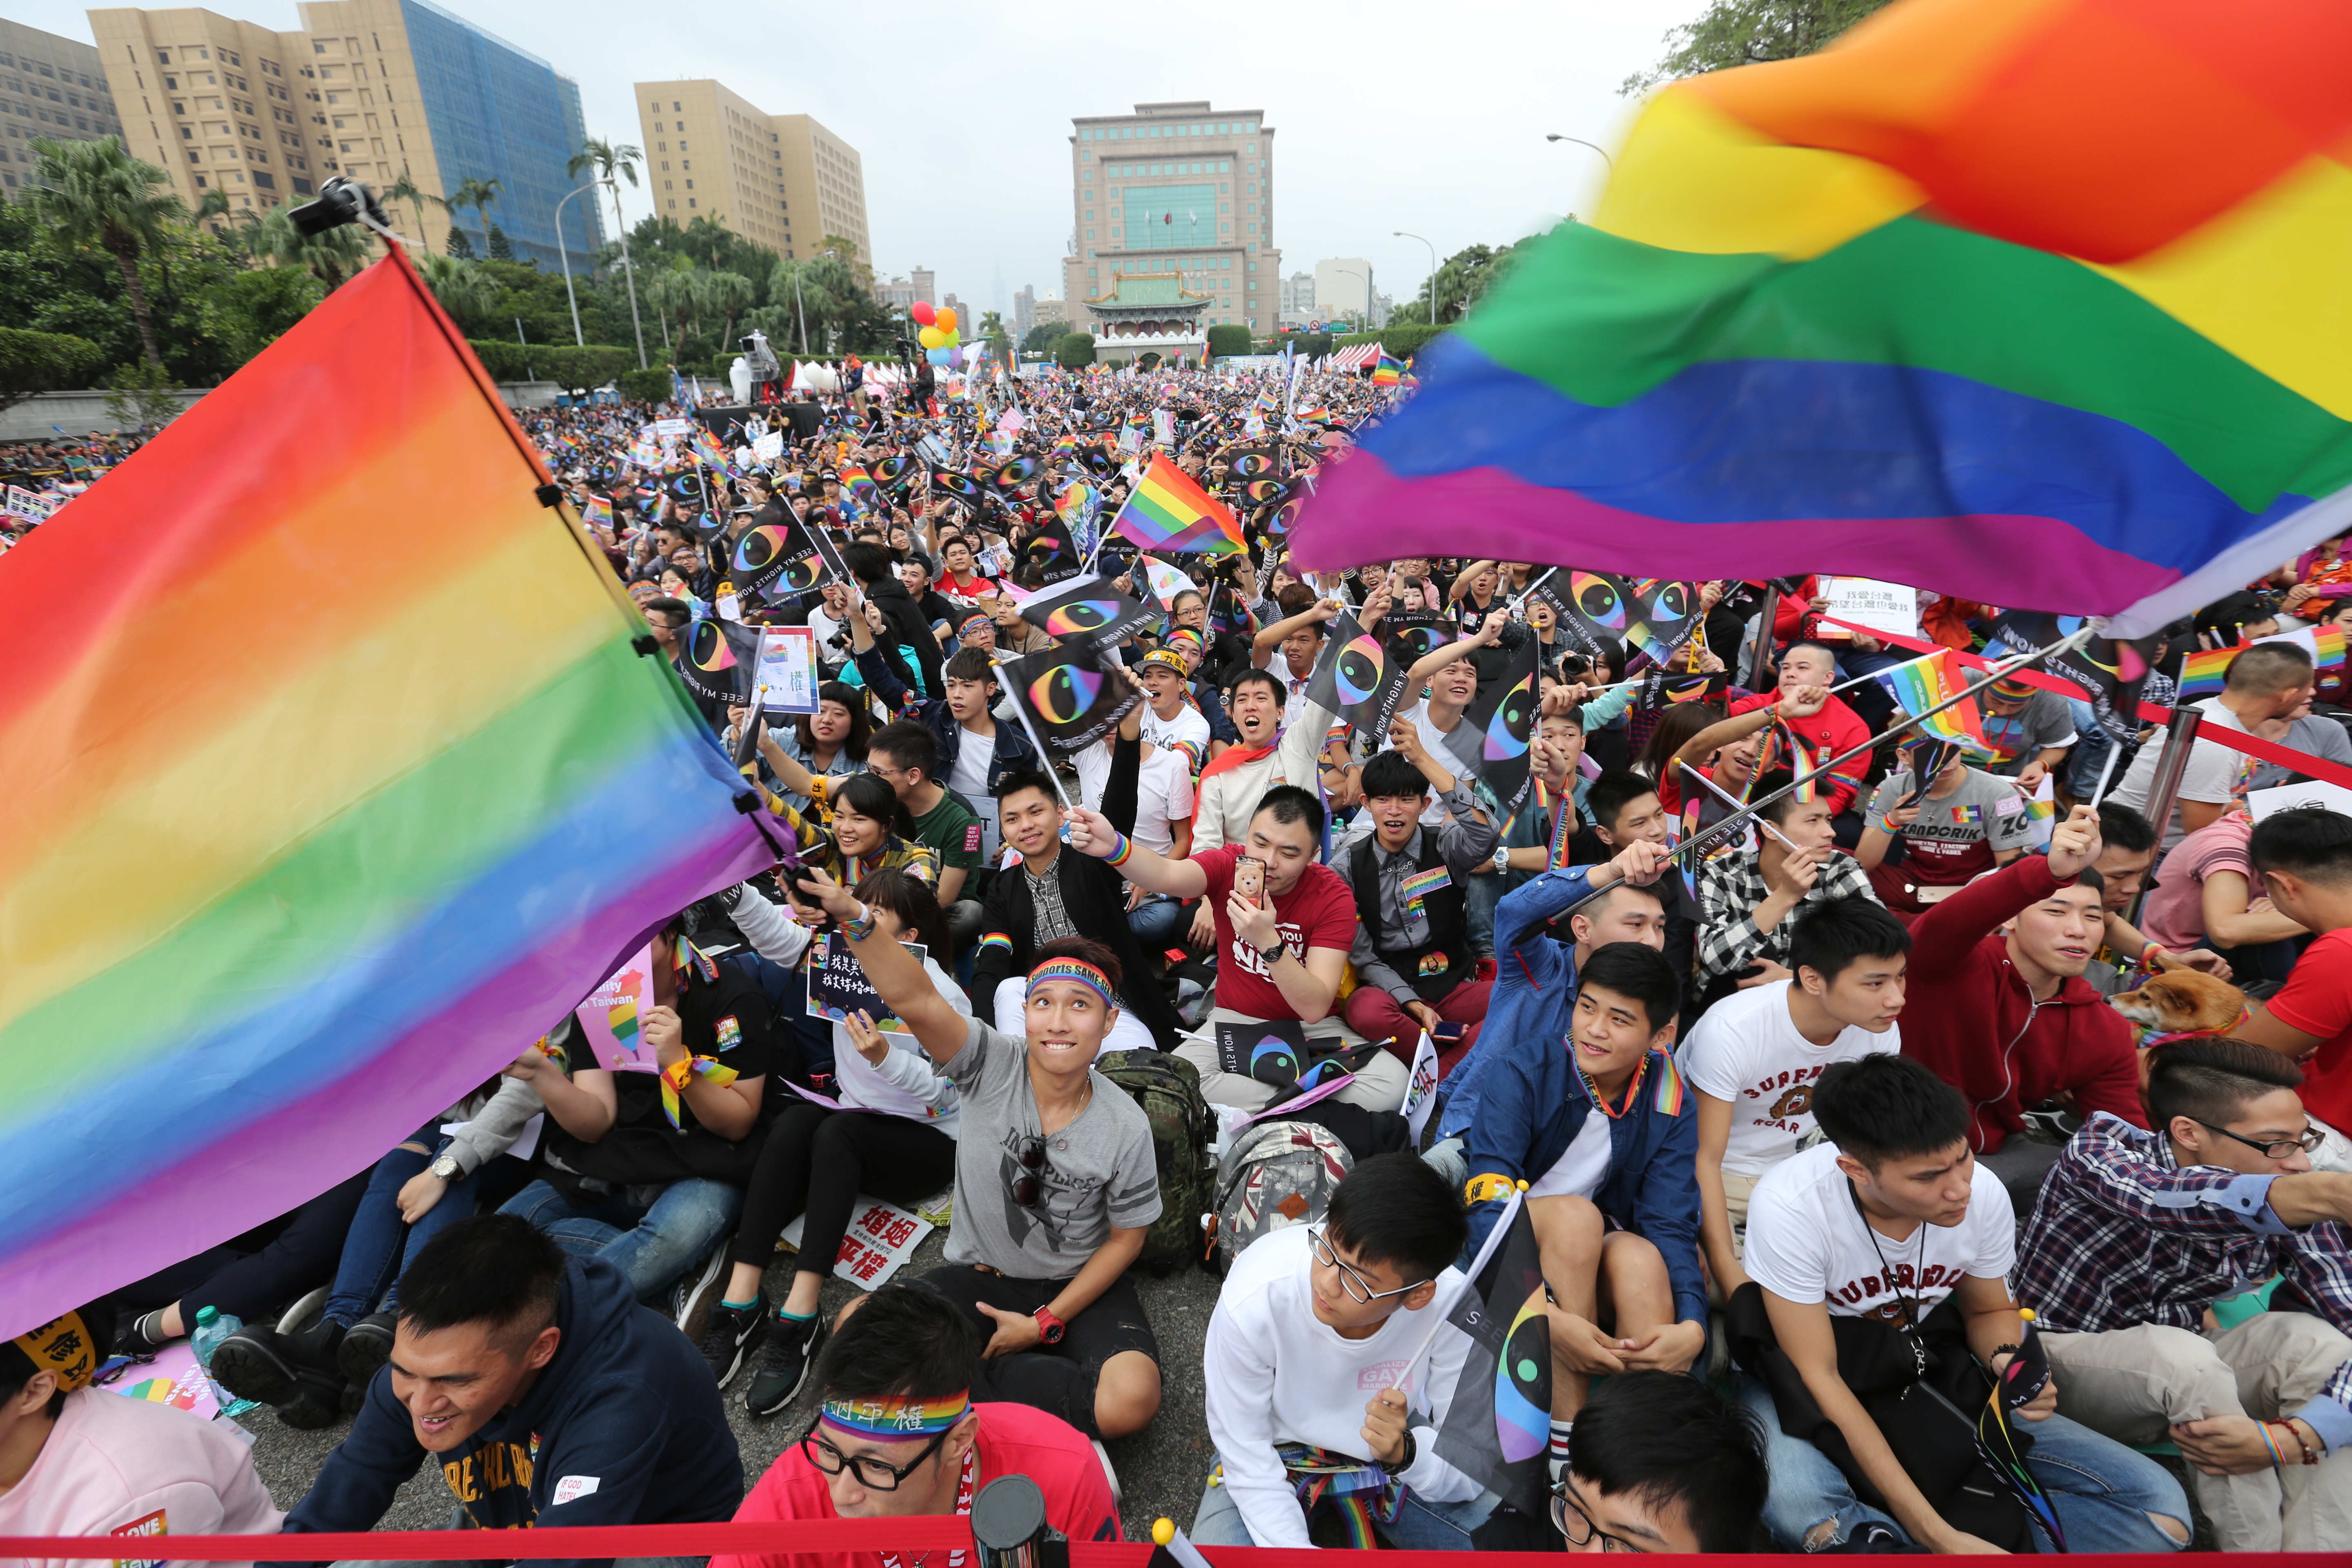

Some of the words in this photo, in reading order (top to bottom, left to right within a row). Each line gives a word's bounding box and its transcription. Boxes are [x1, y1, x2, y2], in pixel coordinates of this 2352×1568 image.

[1846, 590, 1893, 601] 我愛台灣
[1100, 623, 1135, 645] RIGHTS
[1130, 610, 1159, 627] NOW!
[1539, 585, 1555, 599] SEE
[1553, 598, 1566, 611] MY
[1563, 609, 1587, 638] RIGHTS
[1585, 635, 1605, 657] NOW!
[1999, 801, 2020, 811] GAY
[1280, 930, 1303, 943] YOU
[1032, 964, 1072, 982] Supports
[592, 982, 622, 996] ality
[589, 994, 633, 1007] Taiwan
[717, 1018, 735, 1031] LOVE
[720, 1030, 727, 1038] IS
[720, 1034, 740, 1047] LOVE
[856, 1205, 918, 1250] 婚姻
[1362, 1368, 1402, 1383] GAY
[163, 1363, 199, 1405] Taiwa
[822, 1399, 925, 1432] 姻平權
[561, 1479, 568, 1488] IF
[568, 1480, 582, 1490] GOD
